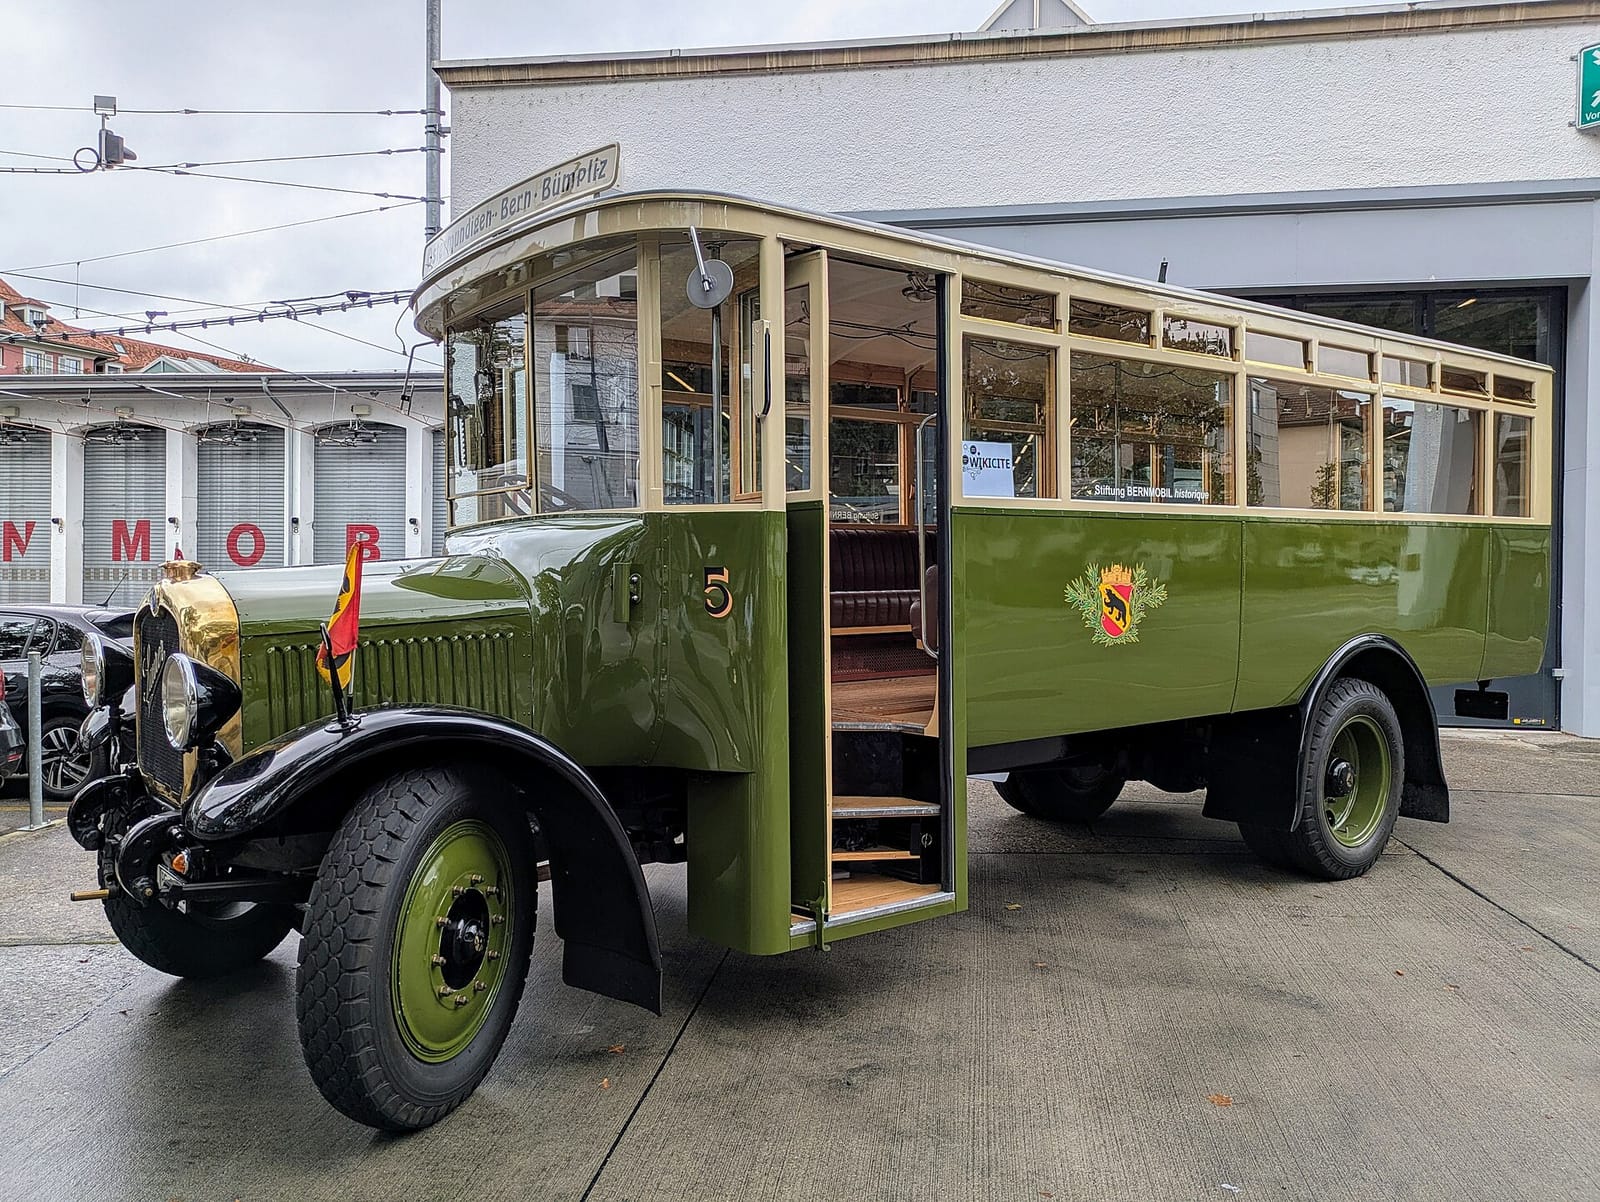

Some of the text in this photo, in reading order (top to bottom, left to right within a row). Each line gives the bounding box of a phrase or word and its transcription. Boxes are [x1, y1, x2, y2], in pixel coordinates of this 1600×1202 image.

[500, 190, 532, 220] Bern
[541, 158, 608, 201] Bümpliz
[1094, 484, 1210, 501] Stiftung BERNMOBIL historique
[58, 526, 64, 534] 6
[293, 526, 299, 534] 8
[413, 527, 419, 535] 9
[111, 519, 151, 562] M
[226, 522, 266, 567] O
[345, 523, 381, 562] B
[704, 566, 733, 618] 5
